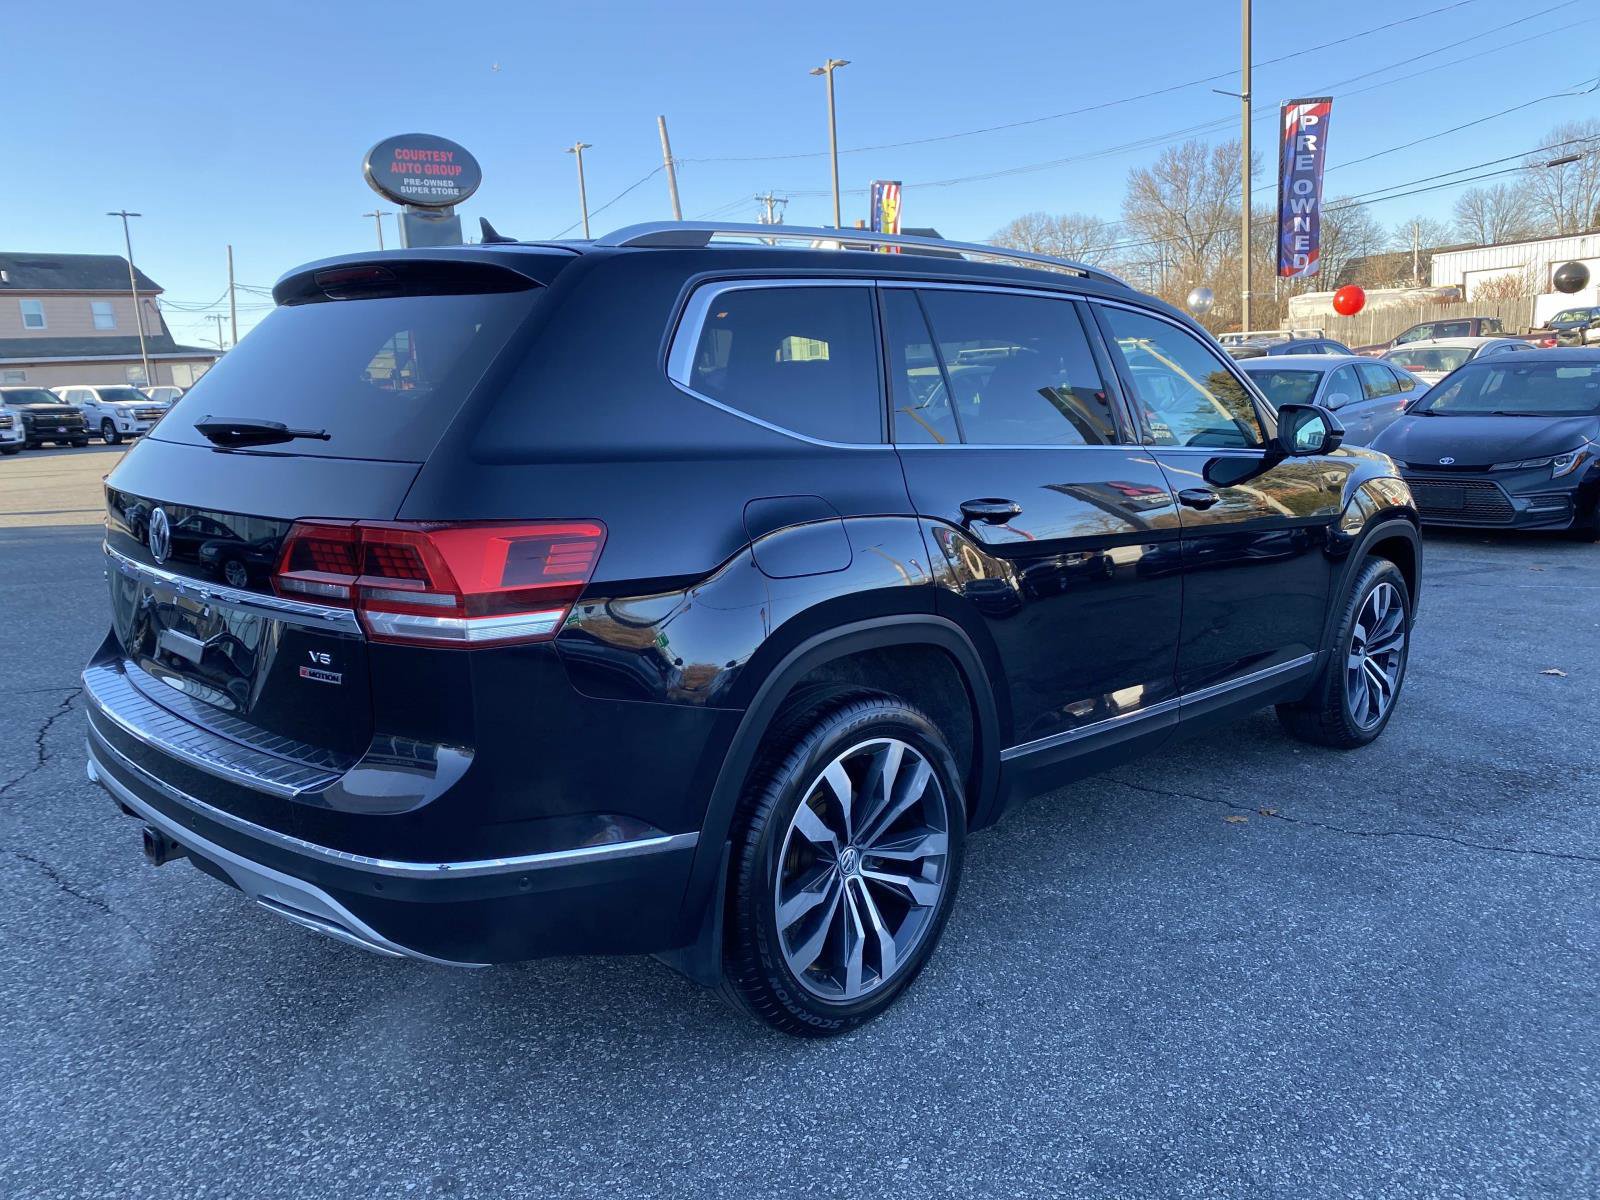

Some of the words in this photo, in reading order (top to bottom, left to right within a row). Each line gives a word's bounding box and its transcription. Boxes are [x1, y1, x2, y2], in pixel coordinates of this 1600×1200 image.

[1296, 115, 1319, 171] PRE
[395, 149, 453, 162] COURTESY
[391, 162, 422, 174] AUTO
[424, 164, 462, 176] GROUP
[404, 178, 454, 187] PRE-OWNED
[401, 186, 429, 194] SUPER
[431, 187, 459, 196] STORE
[1290, 179, 1316, 269] OWNED
[309, 651, 331, 664] V6
